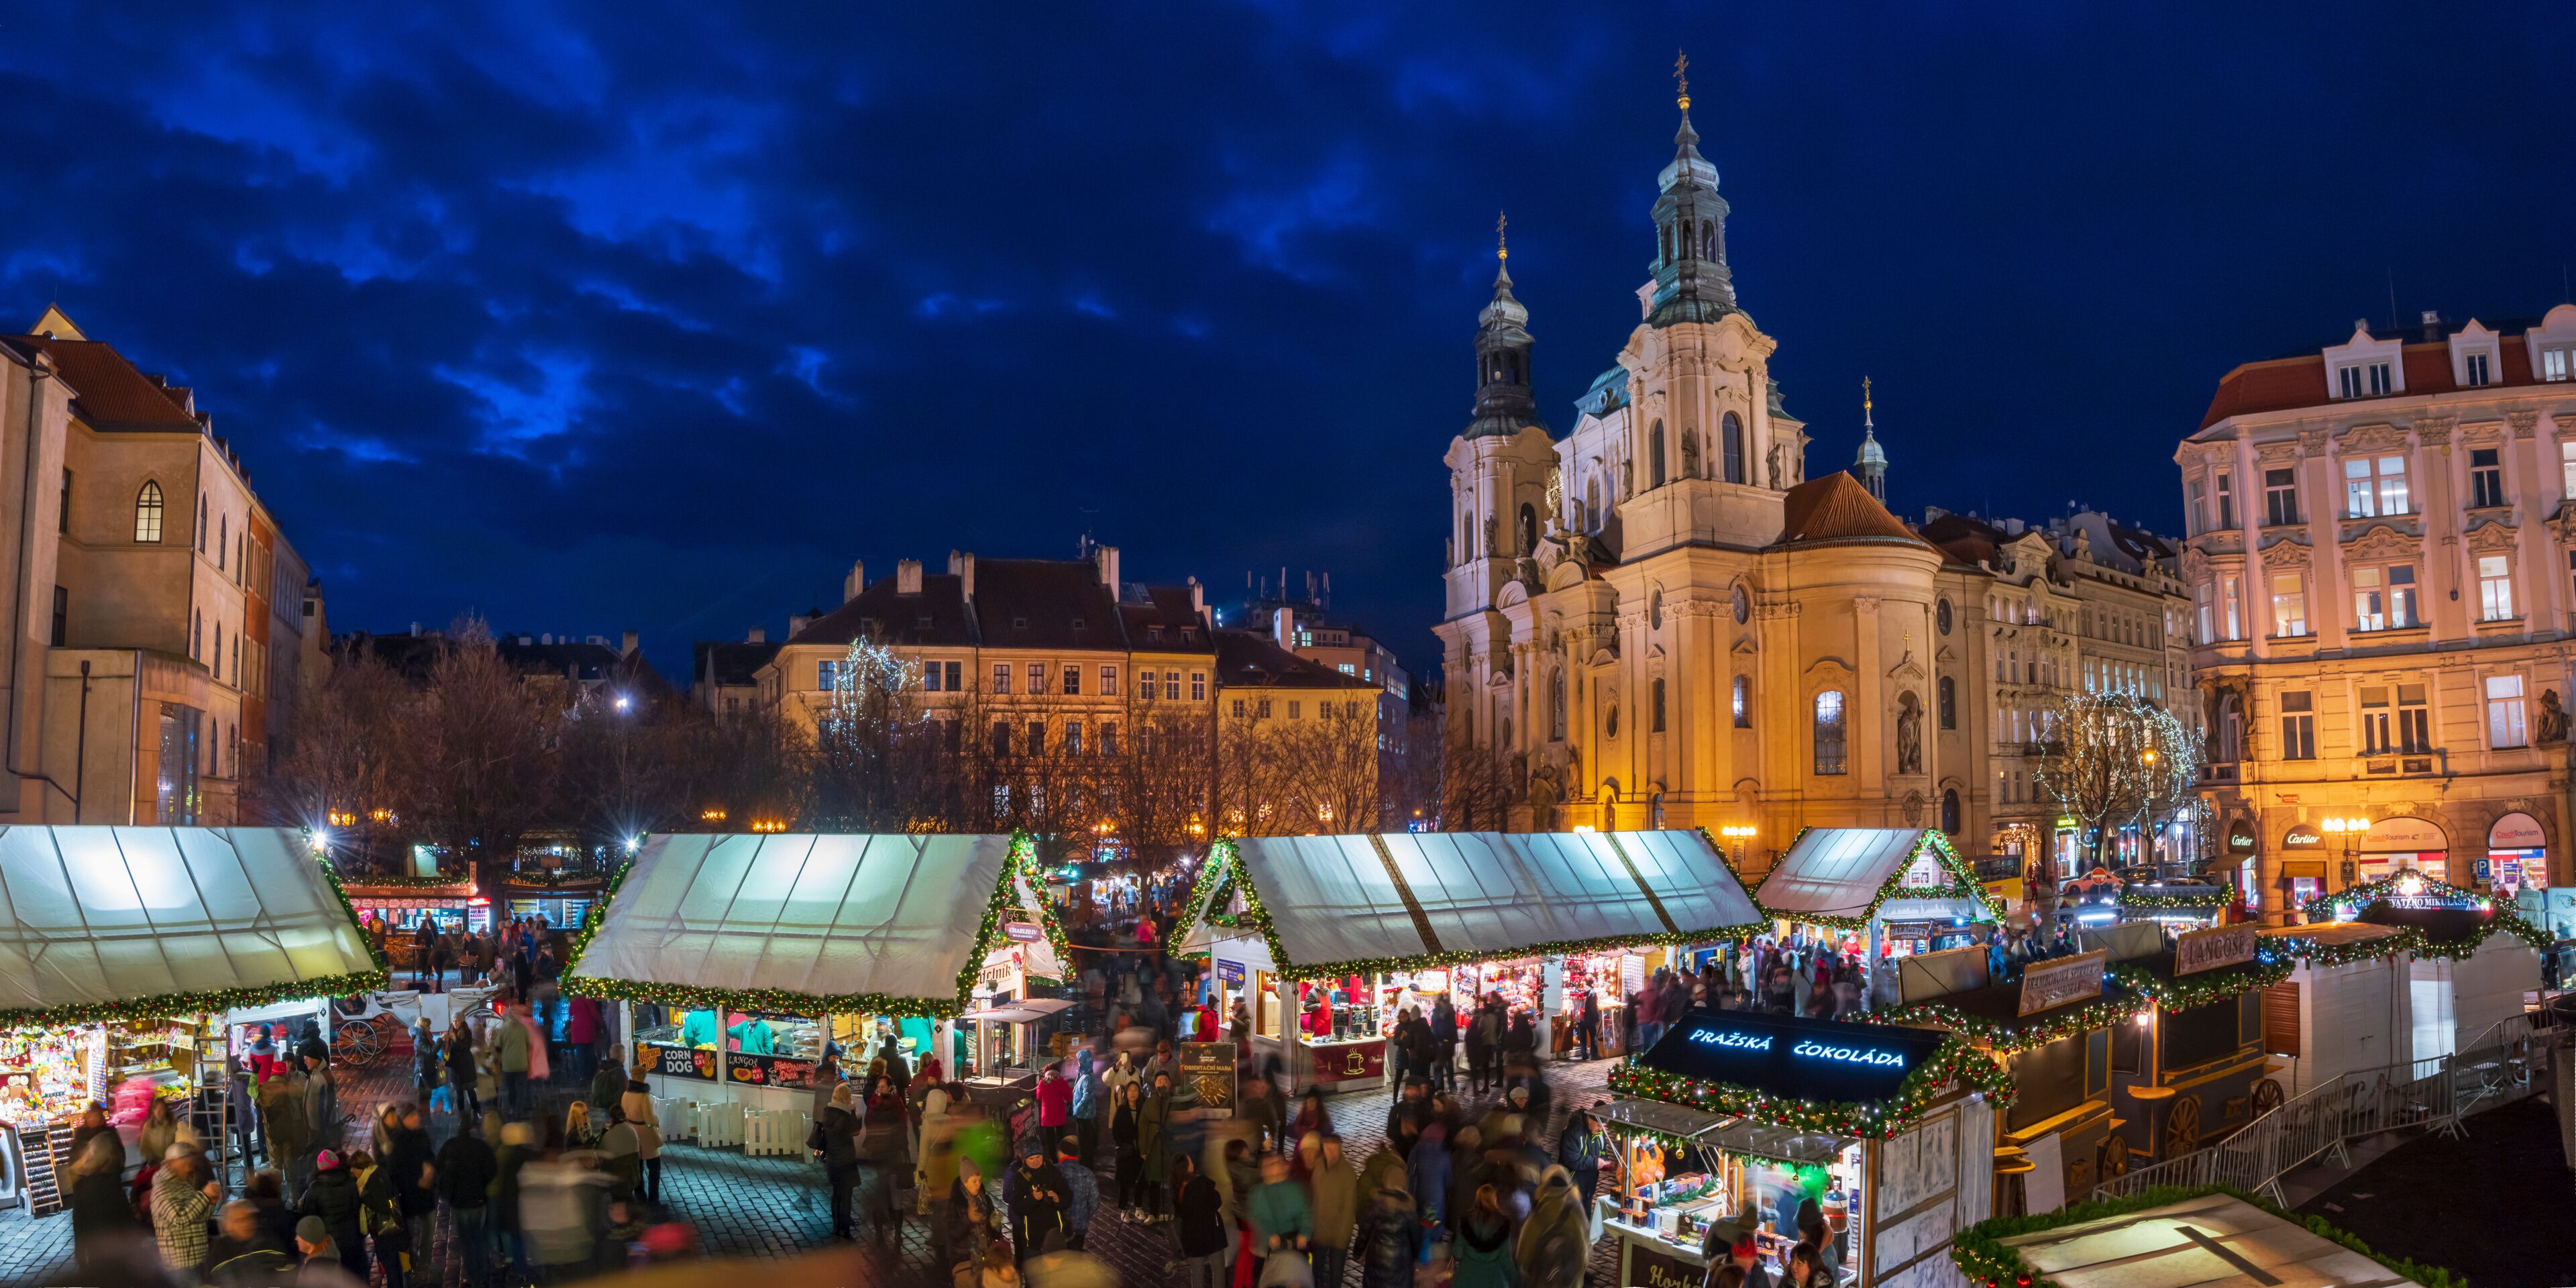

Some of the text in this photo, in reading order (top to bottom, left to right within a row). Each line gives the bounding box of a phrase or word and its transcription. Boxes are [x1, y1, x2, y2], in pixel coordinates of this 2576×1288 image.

[2287, 833, 2320, 844] Cartier
[2367, 834, 2410, 842] CzechTourism
[2495, 828, 2538, 839] CzechTourism
[2231, 835, 2253, 847] Cartier
[2479, 861, 2487, 873] P
[1890, 925, 1929, 937] PALAČINKY
[1689, 1029, 1904, 1067] PRAŽSKÁ ČOKOLÁDA
[665, 1051, 691, 1060] CORN
[666, 1061, 694, 1073] DOG
[729, 1056, 758, 1068] LANGOŠ
[779, 1071, 798, 1080] Drink
